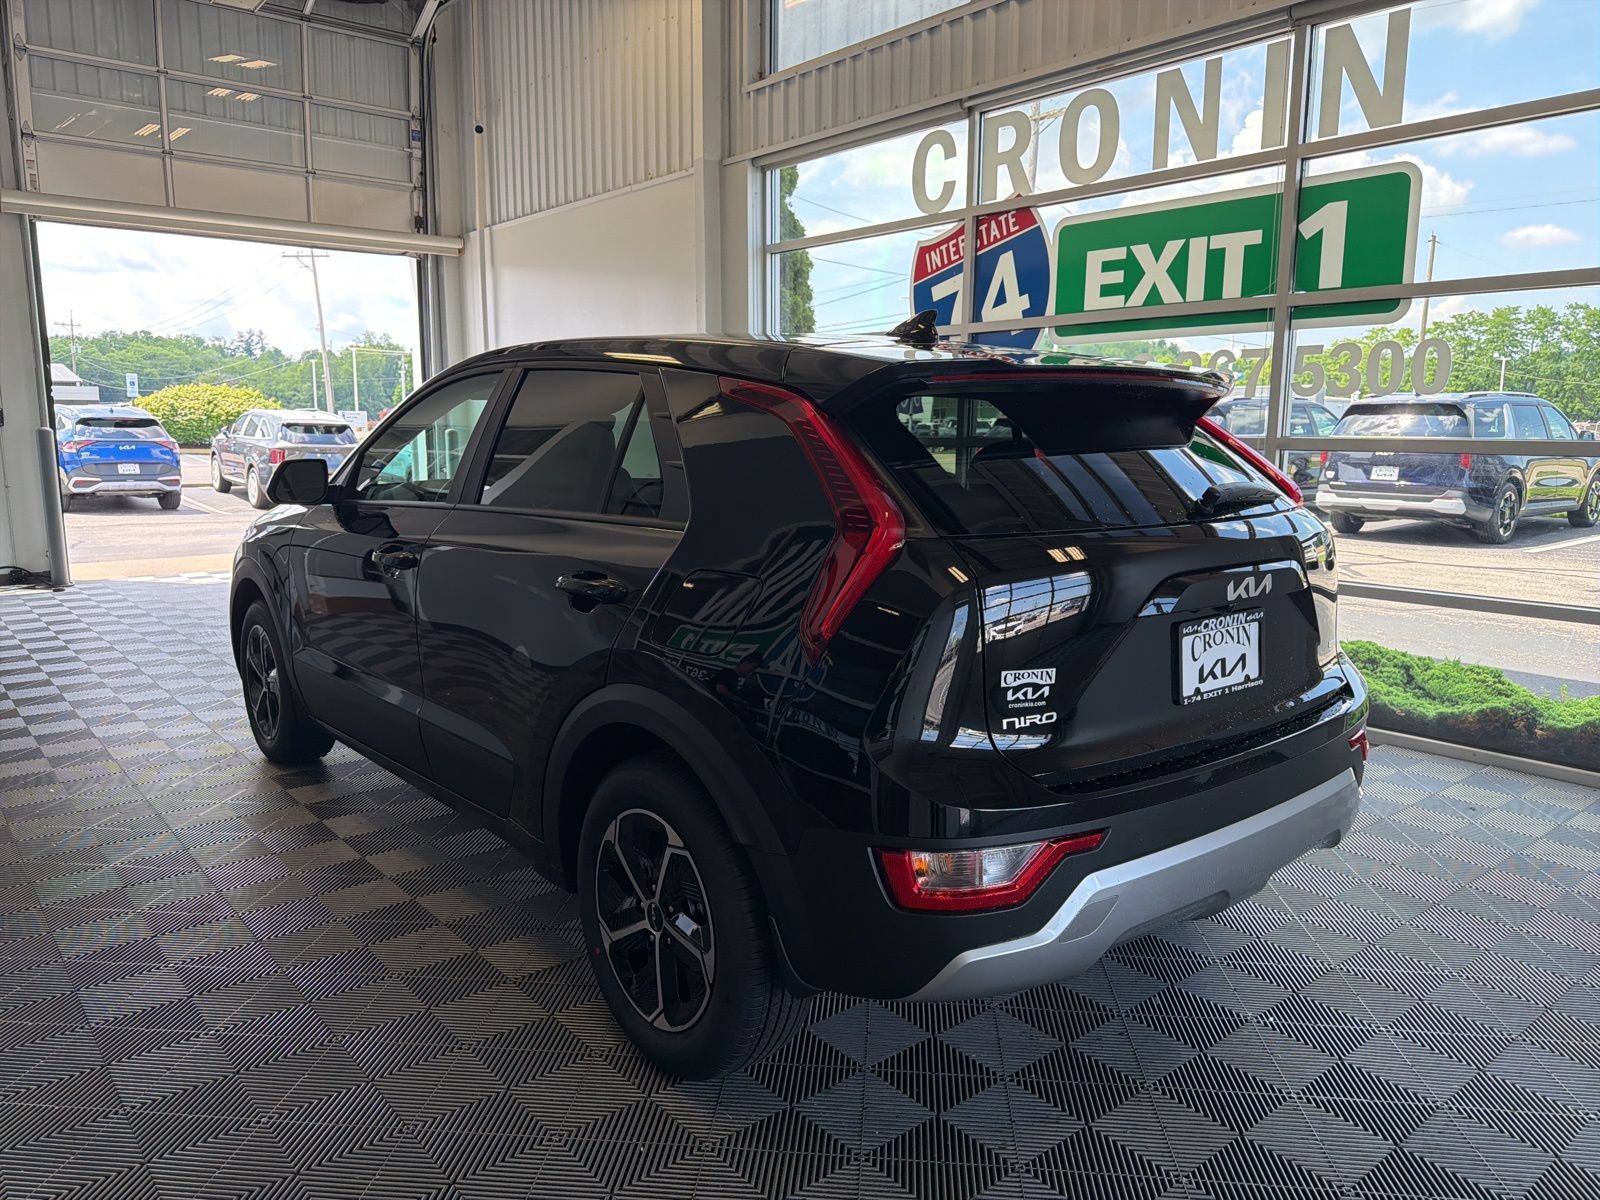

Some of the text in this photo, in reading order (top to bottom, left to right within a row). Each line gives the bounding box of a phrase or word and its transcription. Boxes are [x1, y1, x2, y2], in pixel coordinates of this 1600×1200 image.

[912, 8, 1411, 214] CRONIN
[924, 210, 1020, 273] INTERTATE
[1084, 200, 1349, 312] EXIT 1
[931, 250, 1030, 340] 74
[1226, 573, 1273, 602] KIA
[1200, 612, 1247, 632] CRONIN
[1191, 624, 1252, 662] CRONIN
[1003, 669, 1054, 686] CRONIN
[1198, 652, 1248, 685] KIA
[1006, 685, 1050, 701] KIA
[1008, 701, 1047, 709] croninkia.com
[1183, 693, 1202, 706] I-74
[1203, 688, 1223, 699] EXIT
[1231, 678, 1264, 692] Harrison
[1002, 711, 1058, 730] NIRO
